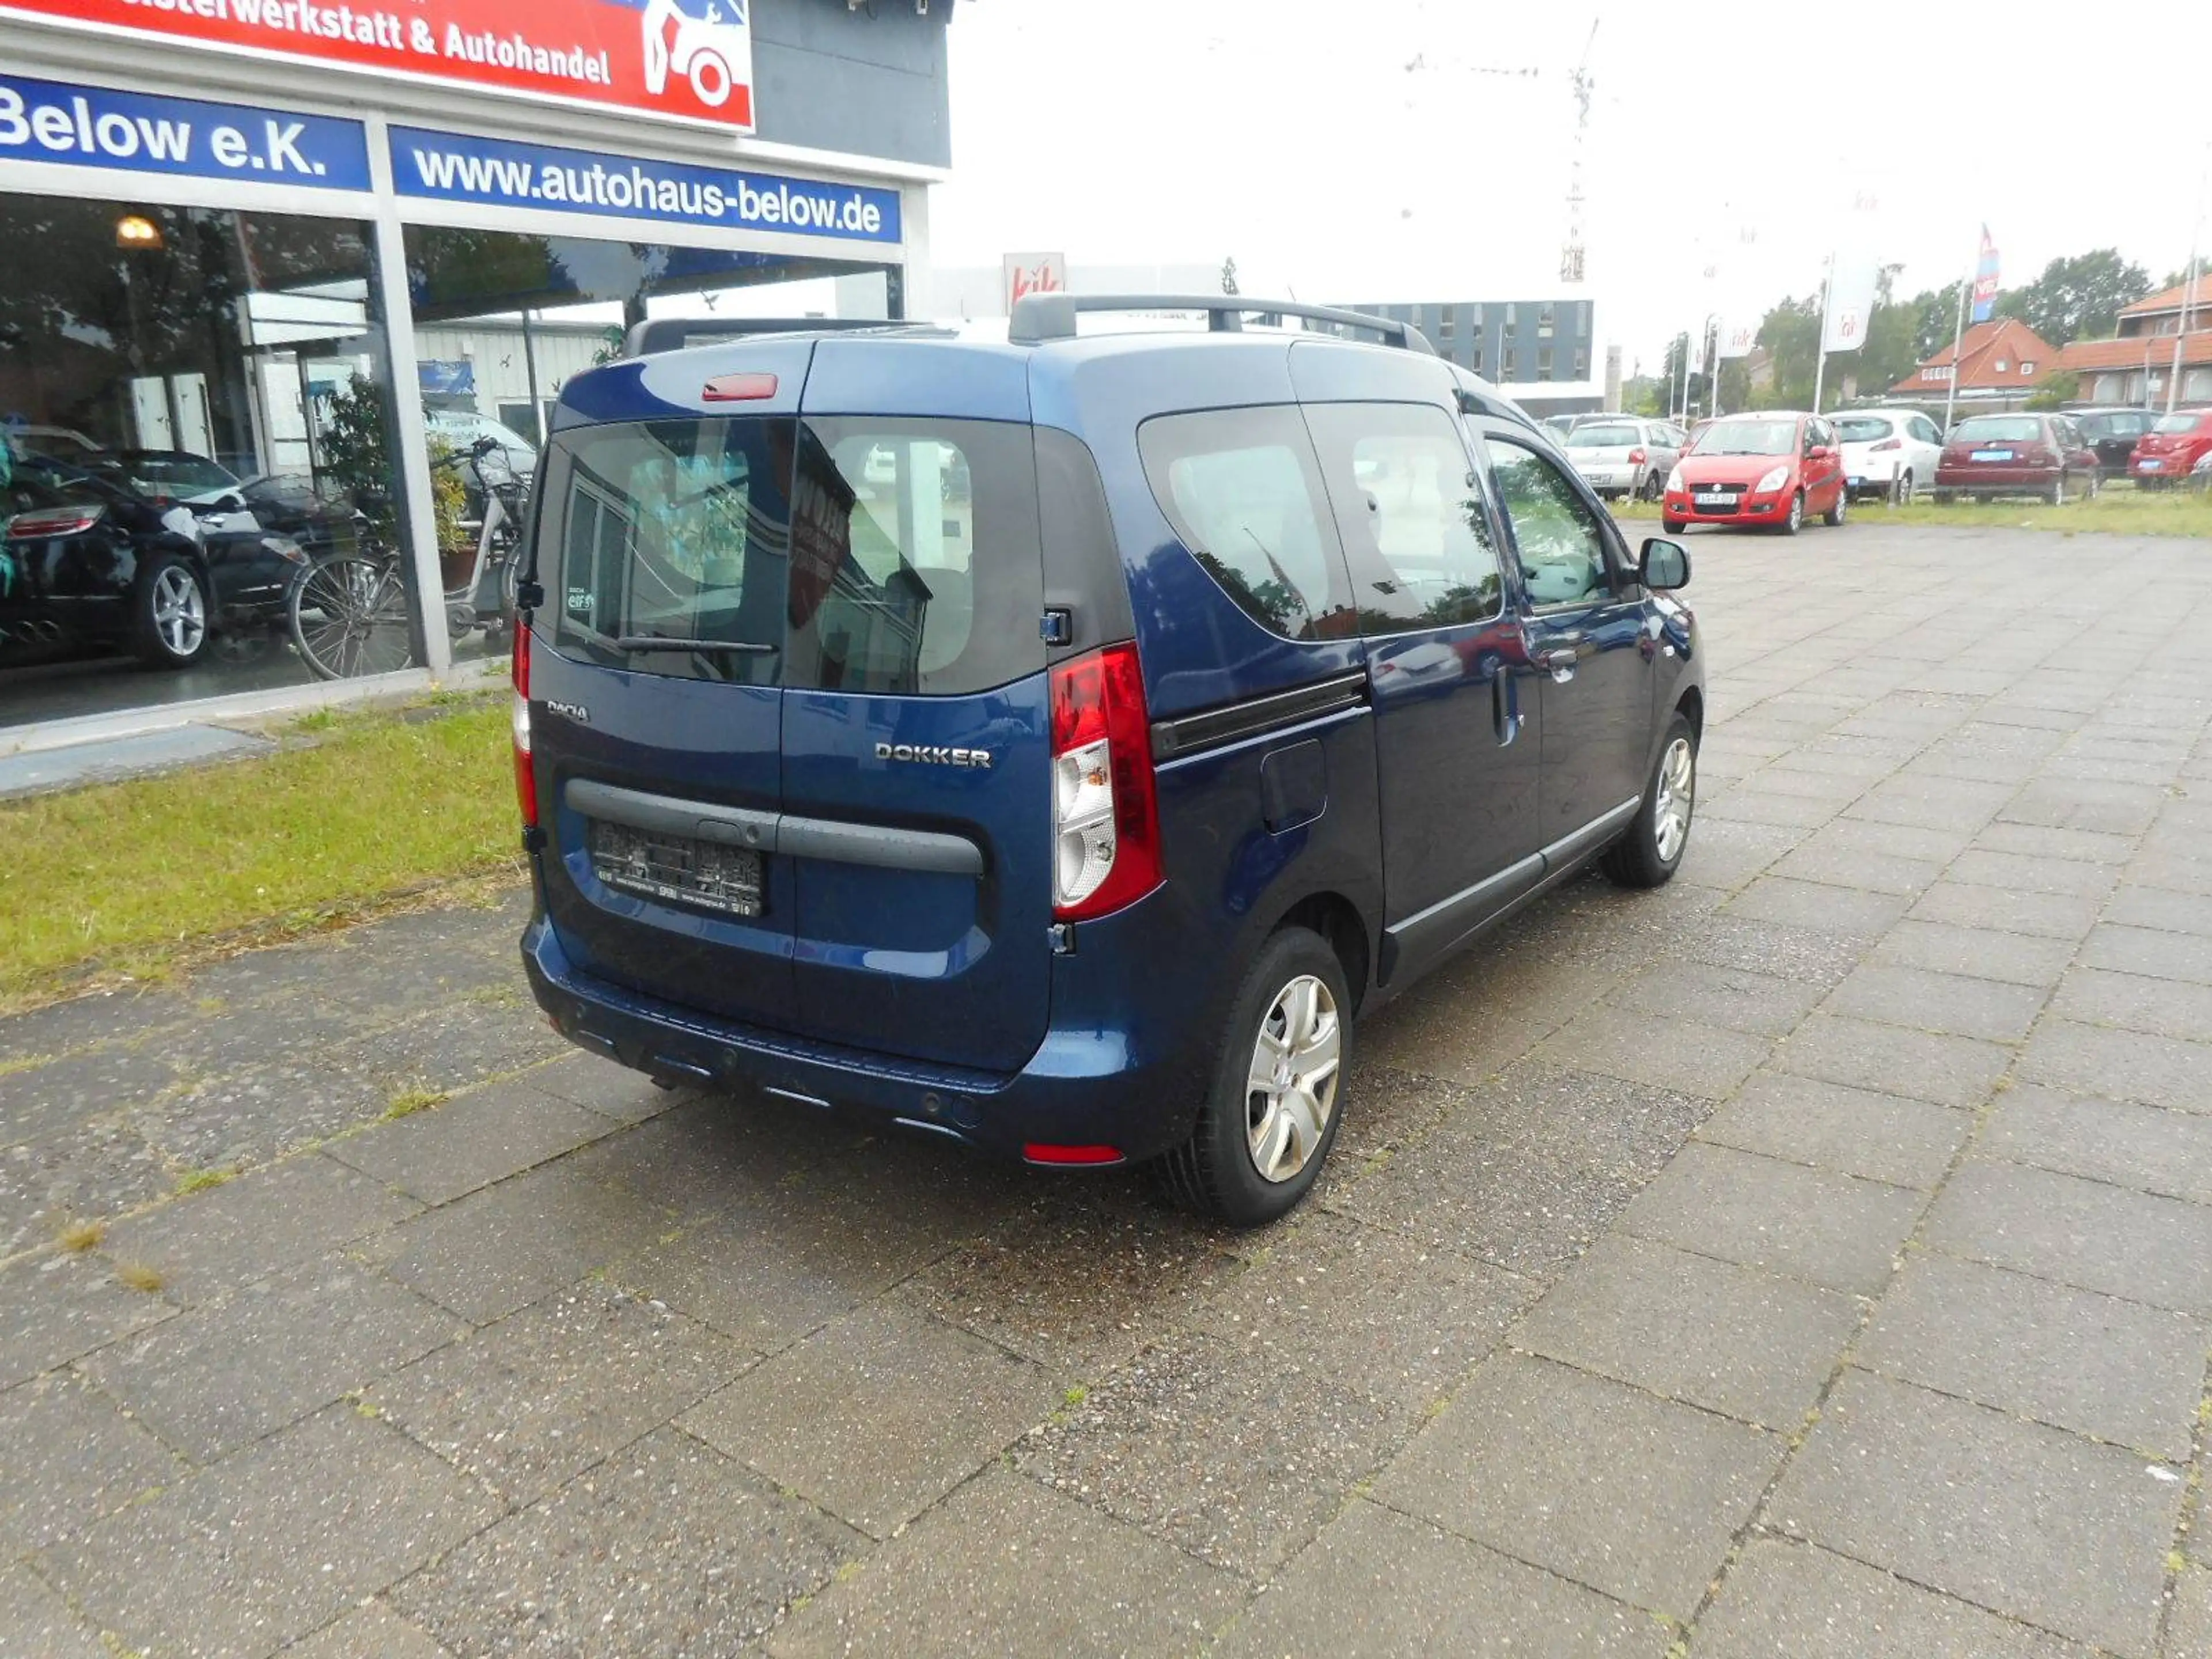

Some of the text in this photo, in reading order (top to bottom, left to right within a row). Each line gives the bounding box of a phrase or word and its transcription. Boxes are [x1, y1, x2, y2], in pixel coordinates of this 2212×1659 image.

[410, 17, 437, 55] &
[445, 22, 611, 85] Autohandel
[0, 86, 326, 176] Below e.K.
[414, 148, 881, 233] www.autohaus-below.de
[547, 700, 588, 718] DACIA
[875, 742, 992, 768] DOKKER
